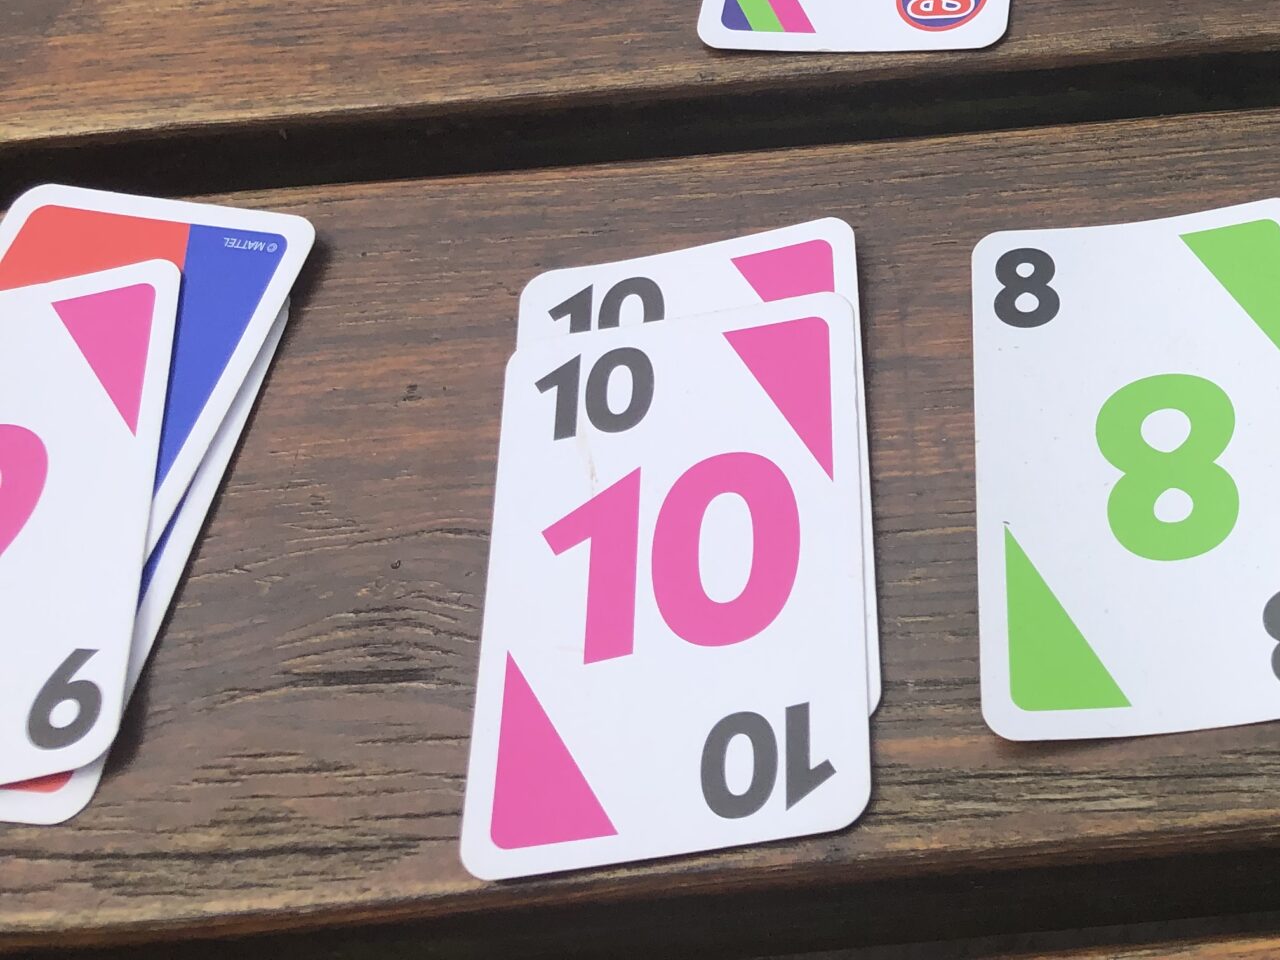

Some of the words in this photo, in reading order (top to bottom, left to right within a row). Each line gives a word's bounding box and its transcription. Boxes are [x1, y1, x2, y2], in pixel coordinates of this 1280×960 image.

[223, 237, 266, 251] MATTEL
[994, 248, 1060, 328] 8
[535, 347, 654, 440] 10
[1096, 373, 1240, 562] 8
[542, 452, 800, 665] 10
[701, 702, 836, 819] 10
